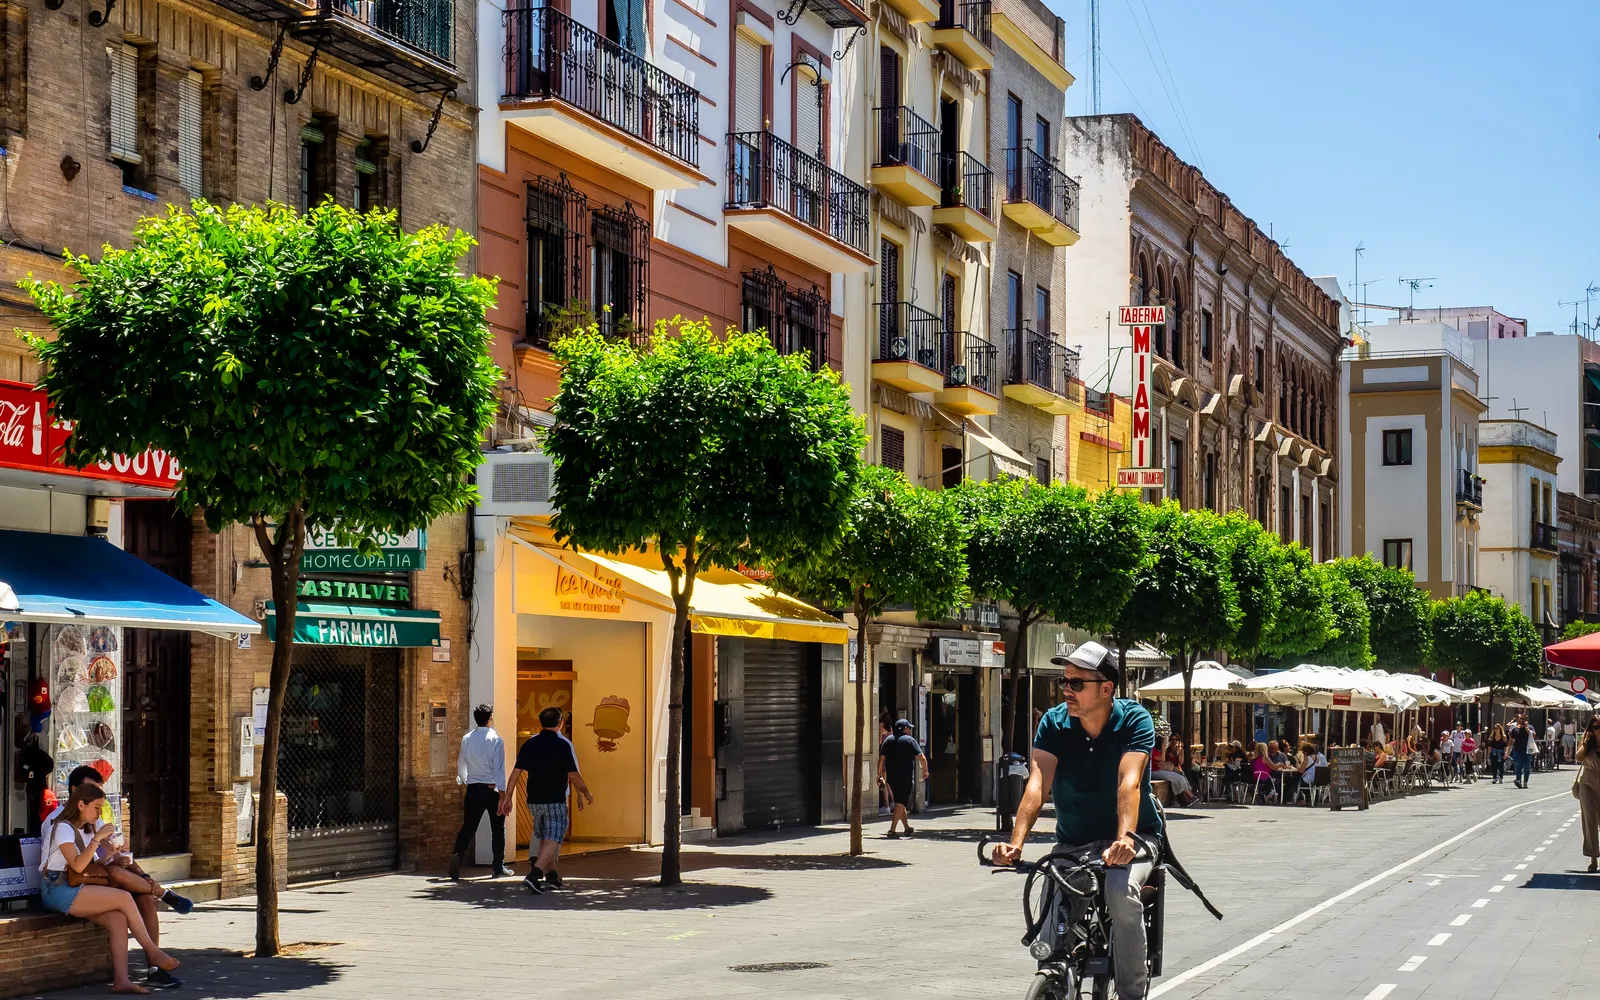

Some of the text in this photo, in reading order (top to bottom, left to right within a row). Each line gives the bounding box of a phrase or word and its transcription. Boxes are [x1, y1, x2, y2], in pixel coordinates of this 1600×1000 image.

[1120, 307, 1164, 324] TABERNA
[1133, 326, 1150, 467] MIAMI
[303, 553, 411, 568] HOMEOPATIA
[740, 568, 771, 578] orange
[318, 619, 398, 645] FARMACIA
